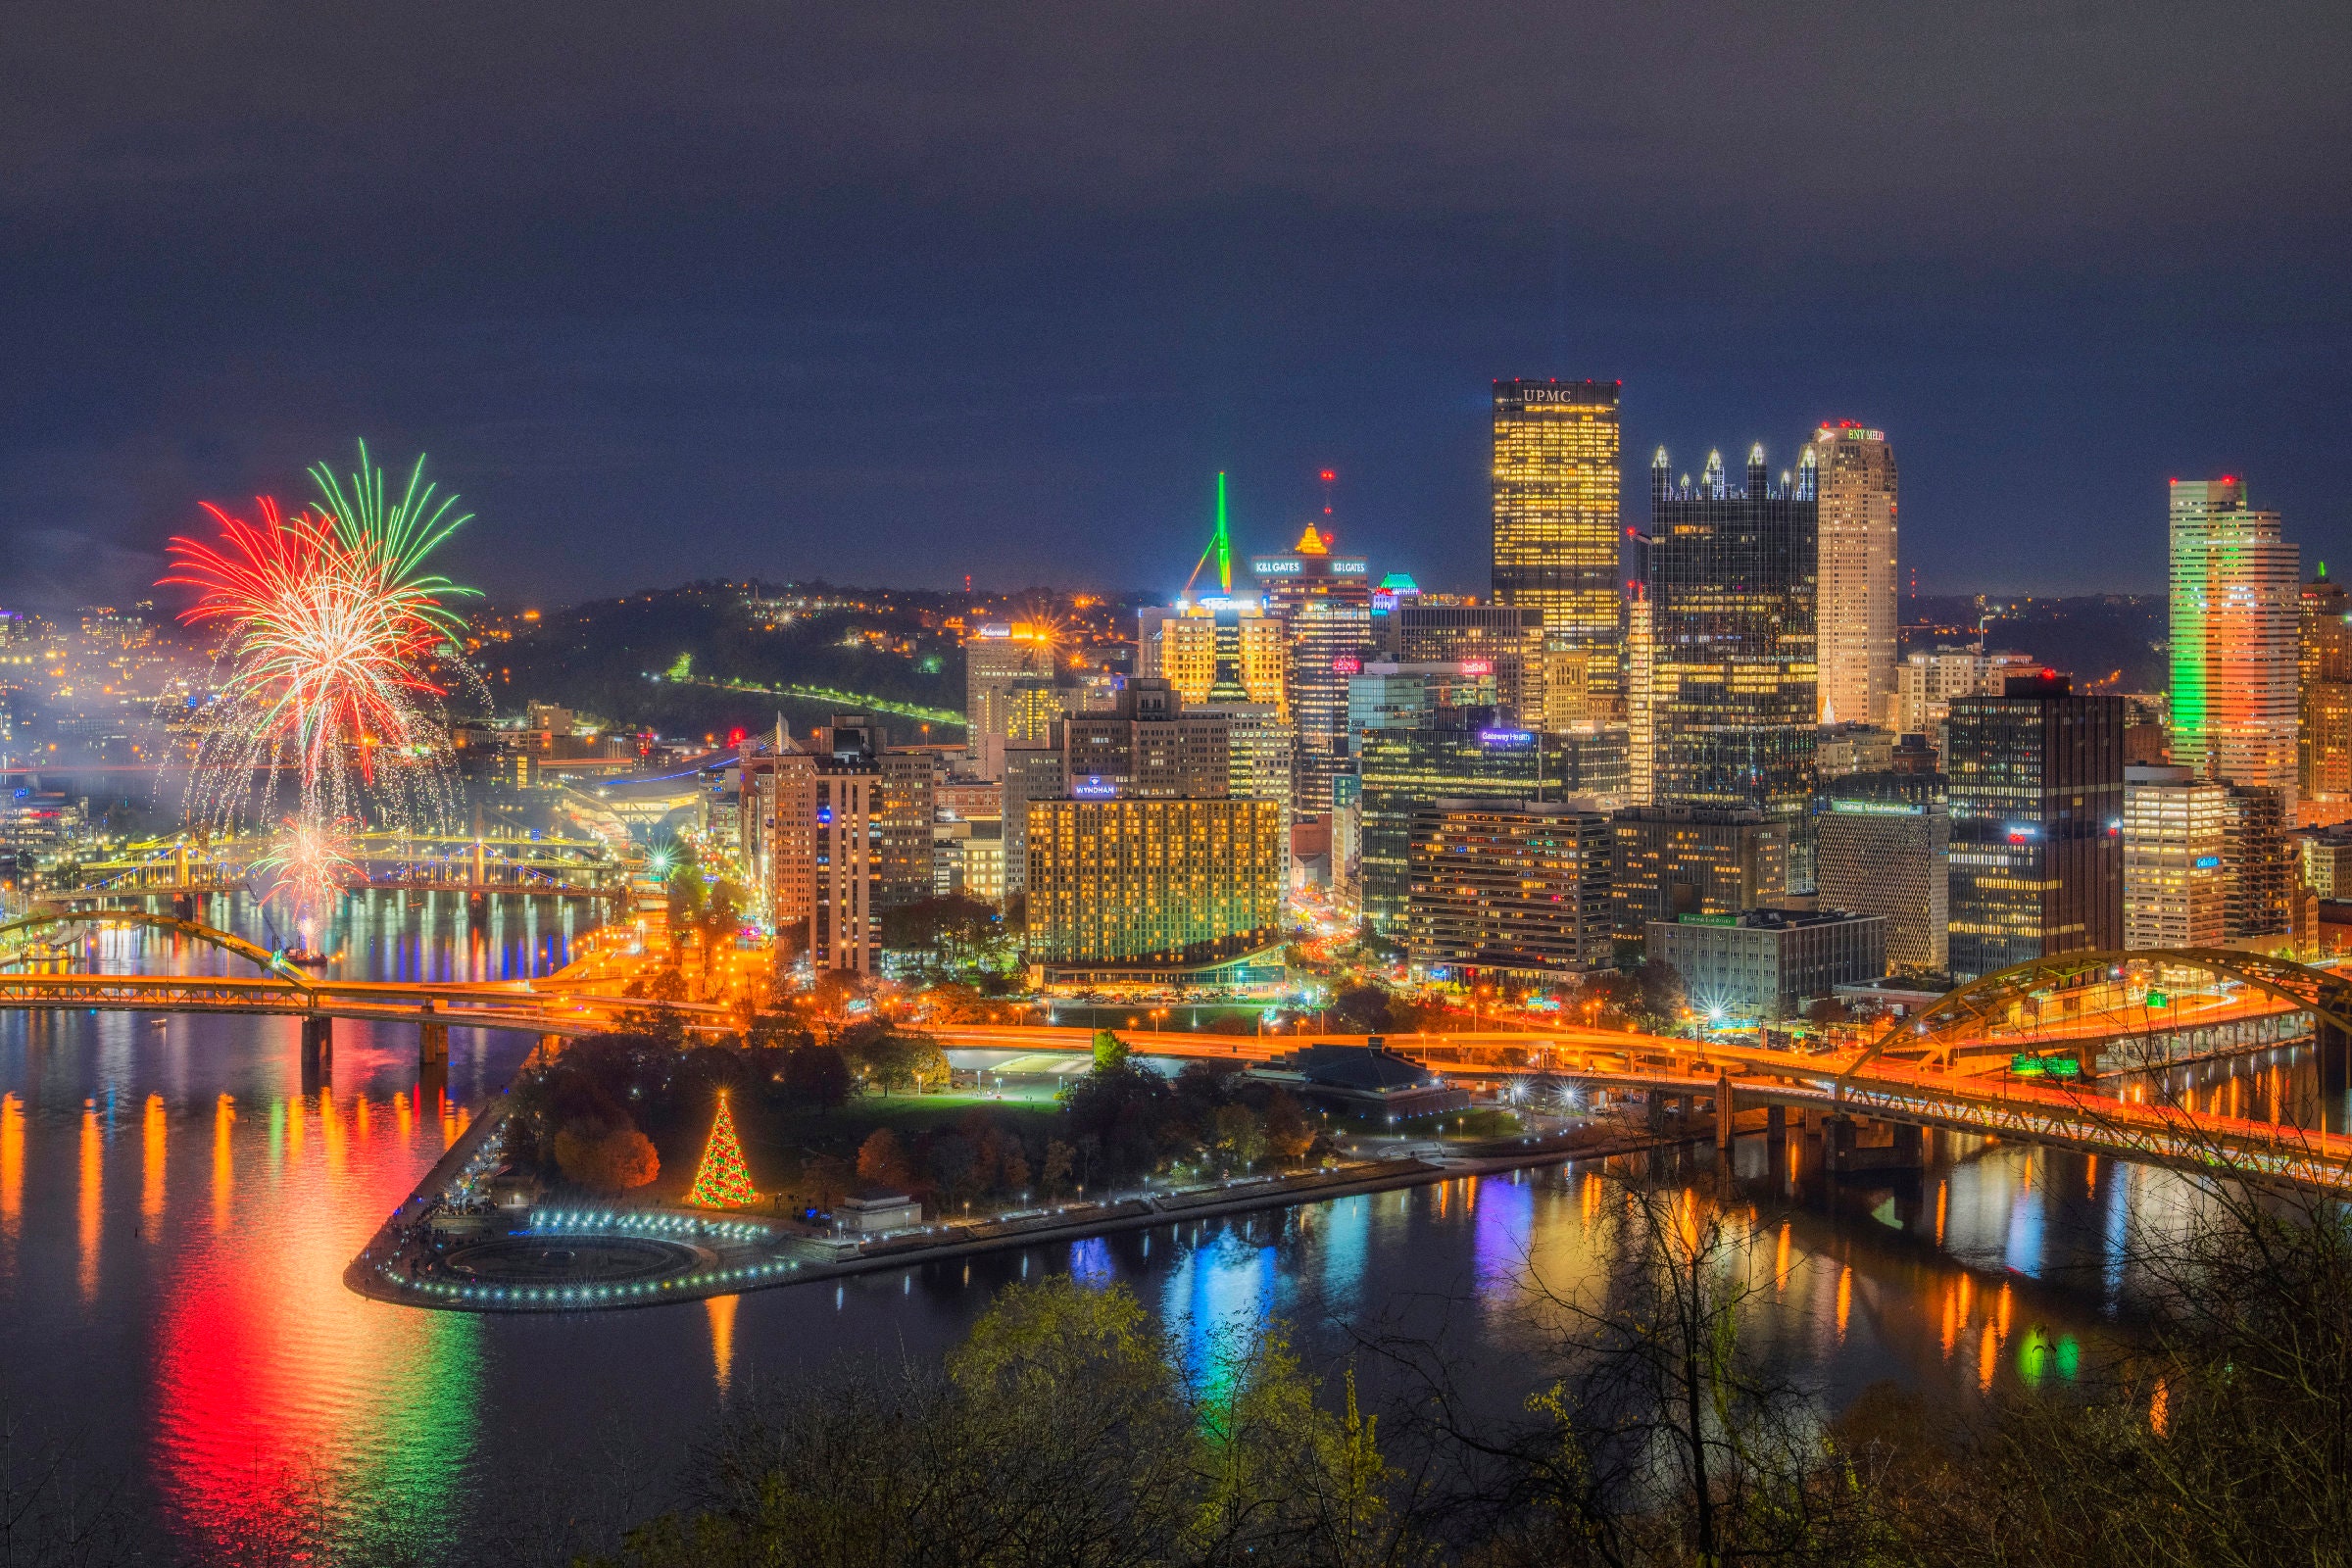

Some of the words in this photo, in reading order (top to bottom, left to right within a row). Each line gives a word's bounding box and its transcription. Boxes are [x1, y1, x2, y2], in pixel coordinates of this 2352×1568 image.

[1523, 389, 1571, 403] UPMC
[1848, 429, 1865, 440] BNY
[1256, 563, 1272, 572] K&L
[1272, 563, 1299, 572] GATES
[1334, 563, 1345, 572] K&L
[1345, 563, 1364, 572] GATES
[1482, 731, 1509, 742] Gateway
[1509, 732, 1530, 741] Health
[1864, 804, 1910, 812] Steelworkers
